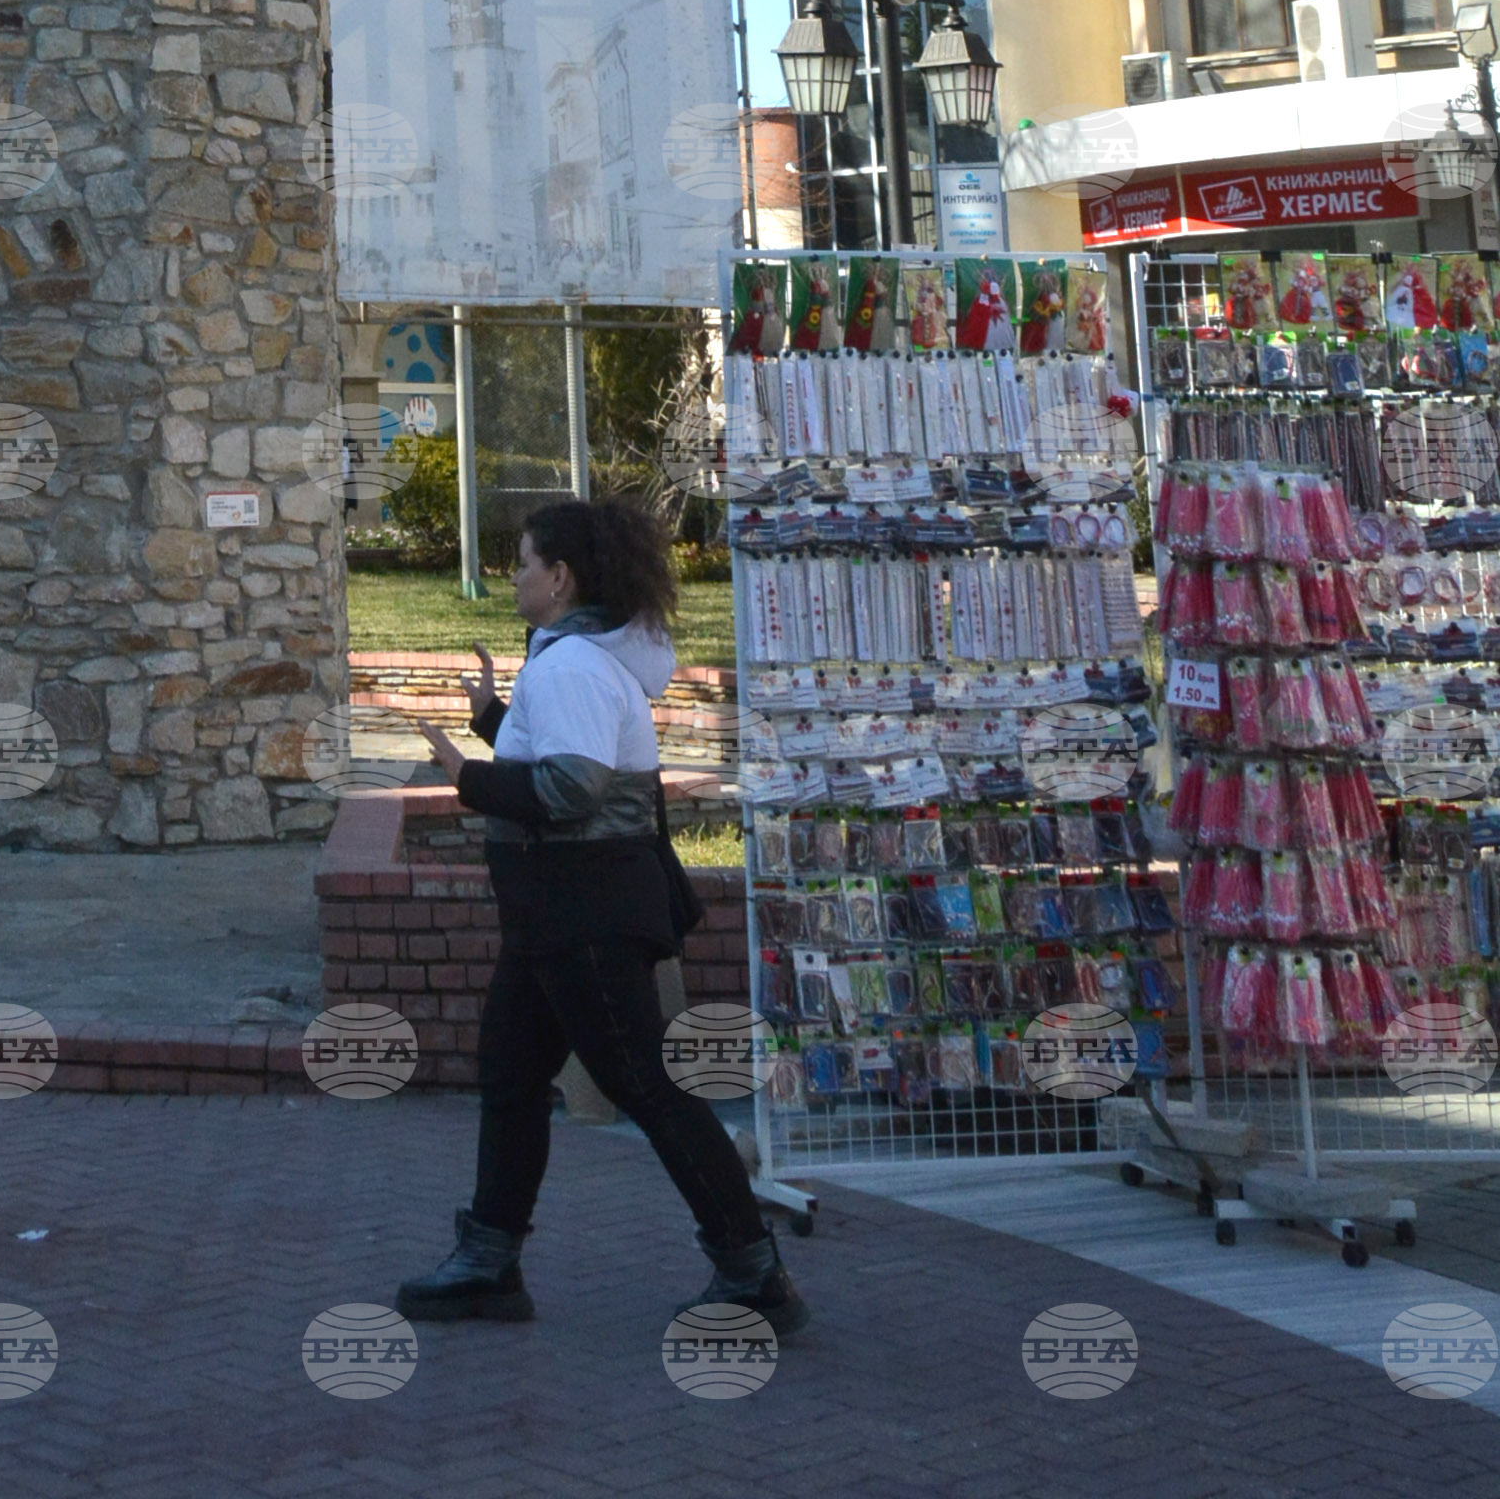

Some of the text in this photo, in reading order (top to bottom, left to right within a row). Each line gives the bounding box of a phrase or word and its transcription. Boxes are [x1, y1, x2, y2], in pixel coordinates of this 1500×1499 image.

[1265, 167, 1397, 192] КНИЖАРНИЦА
[942, 192, 998, 204] ИНТЕРЛИЙЗ
[1279, 189, 1384, 218] ХЕРМЕС
[1122, 207, 1167, 234] ХЕРМЕС
[1179, 663, 1195, 681] 10
[1174, 685, 1202, 702] 1,50
